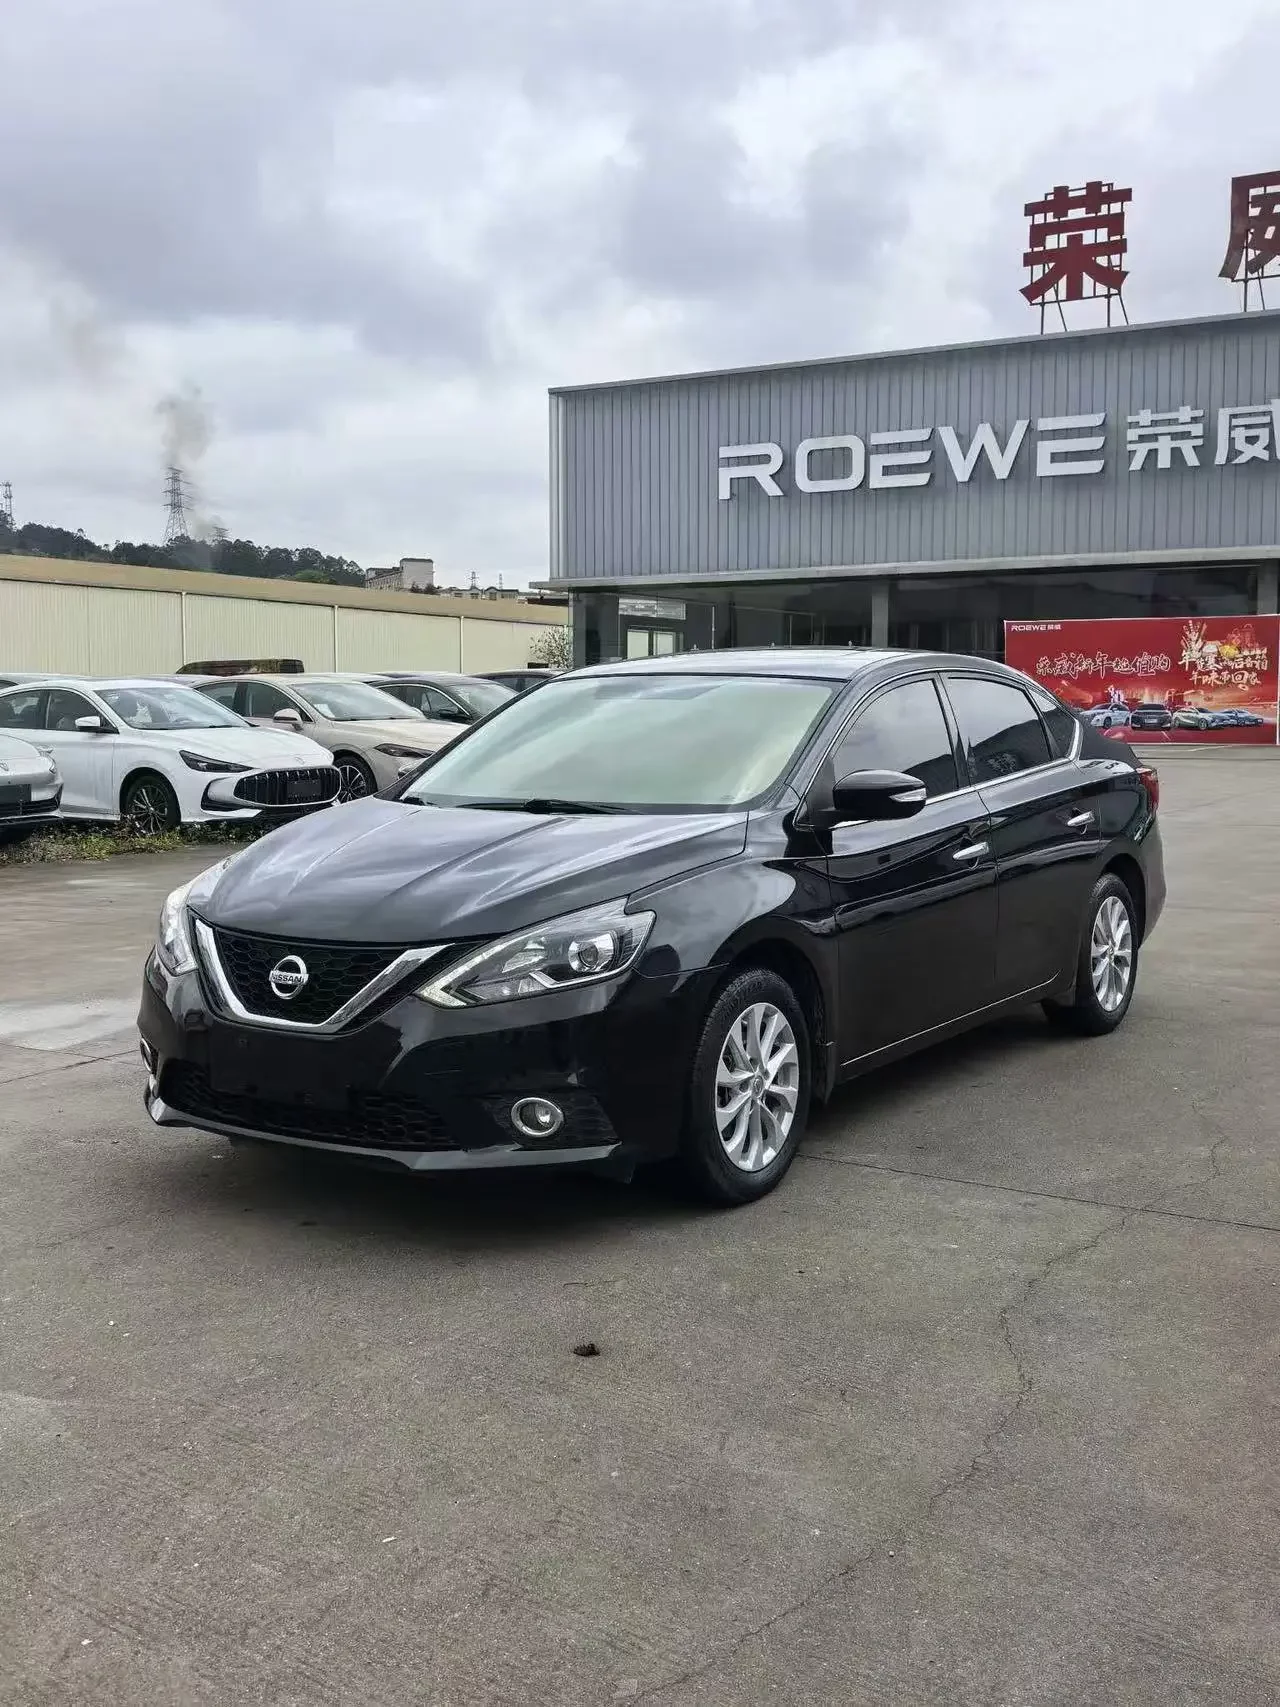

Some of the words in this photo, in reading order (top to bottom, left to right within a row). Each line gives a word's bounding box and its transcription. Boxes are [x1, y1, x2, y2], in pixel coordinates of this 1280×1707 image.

[718, 412, 1106, 500] ROEWE
[1127, 398, 1280, 471] 荣威
[1011, 624, 1047, 632] ROEWE
[271, 973, 303, 983] NISSAN
